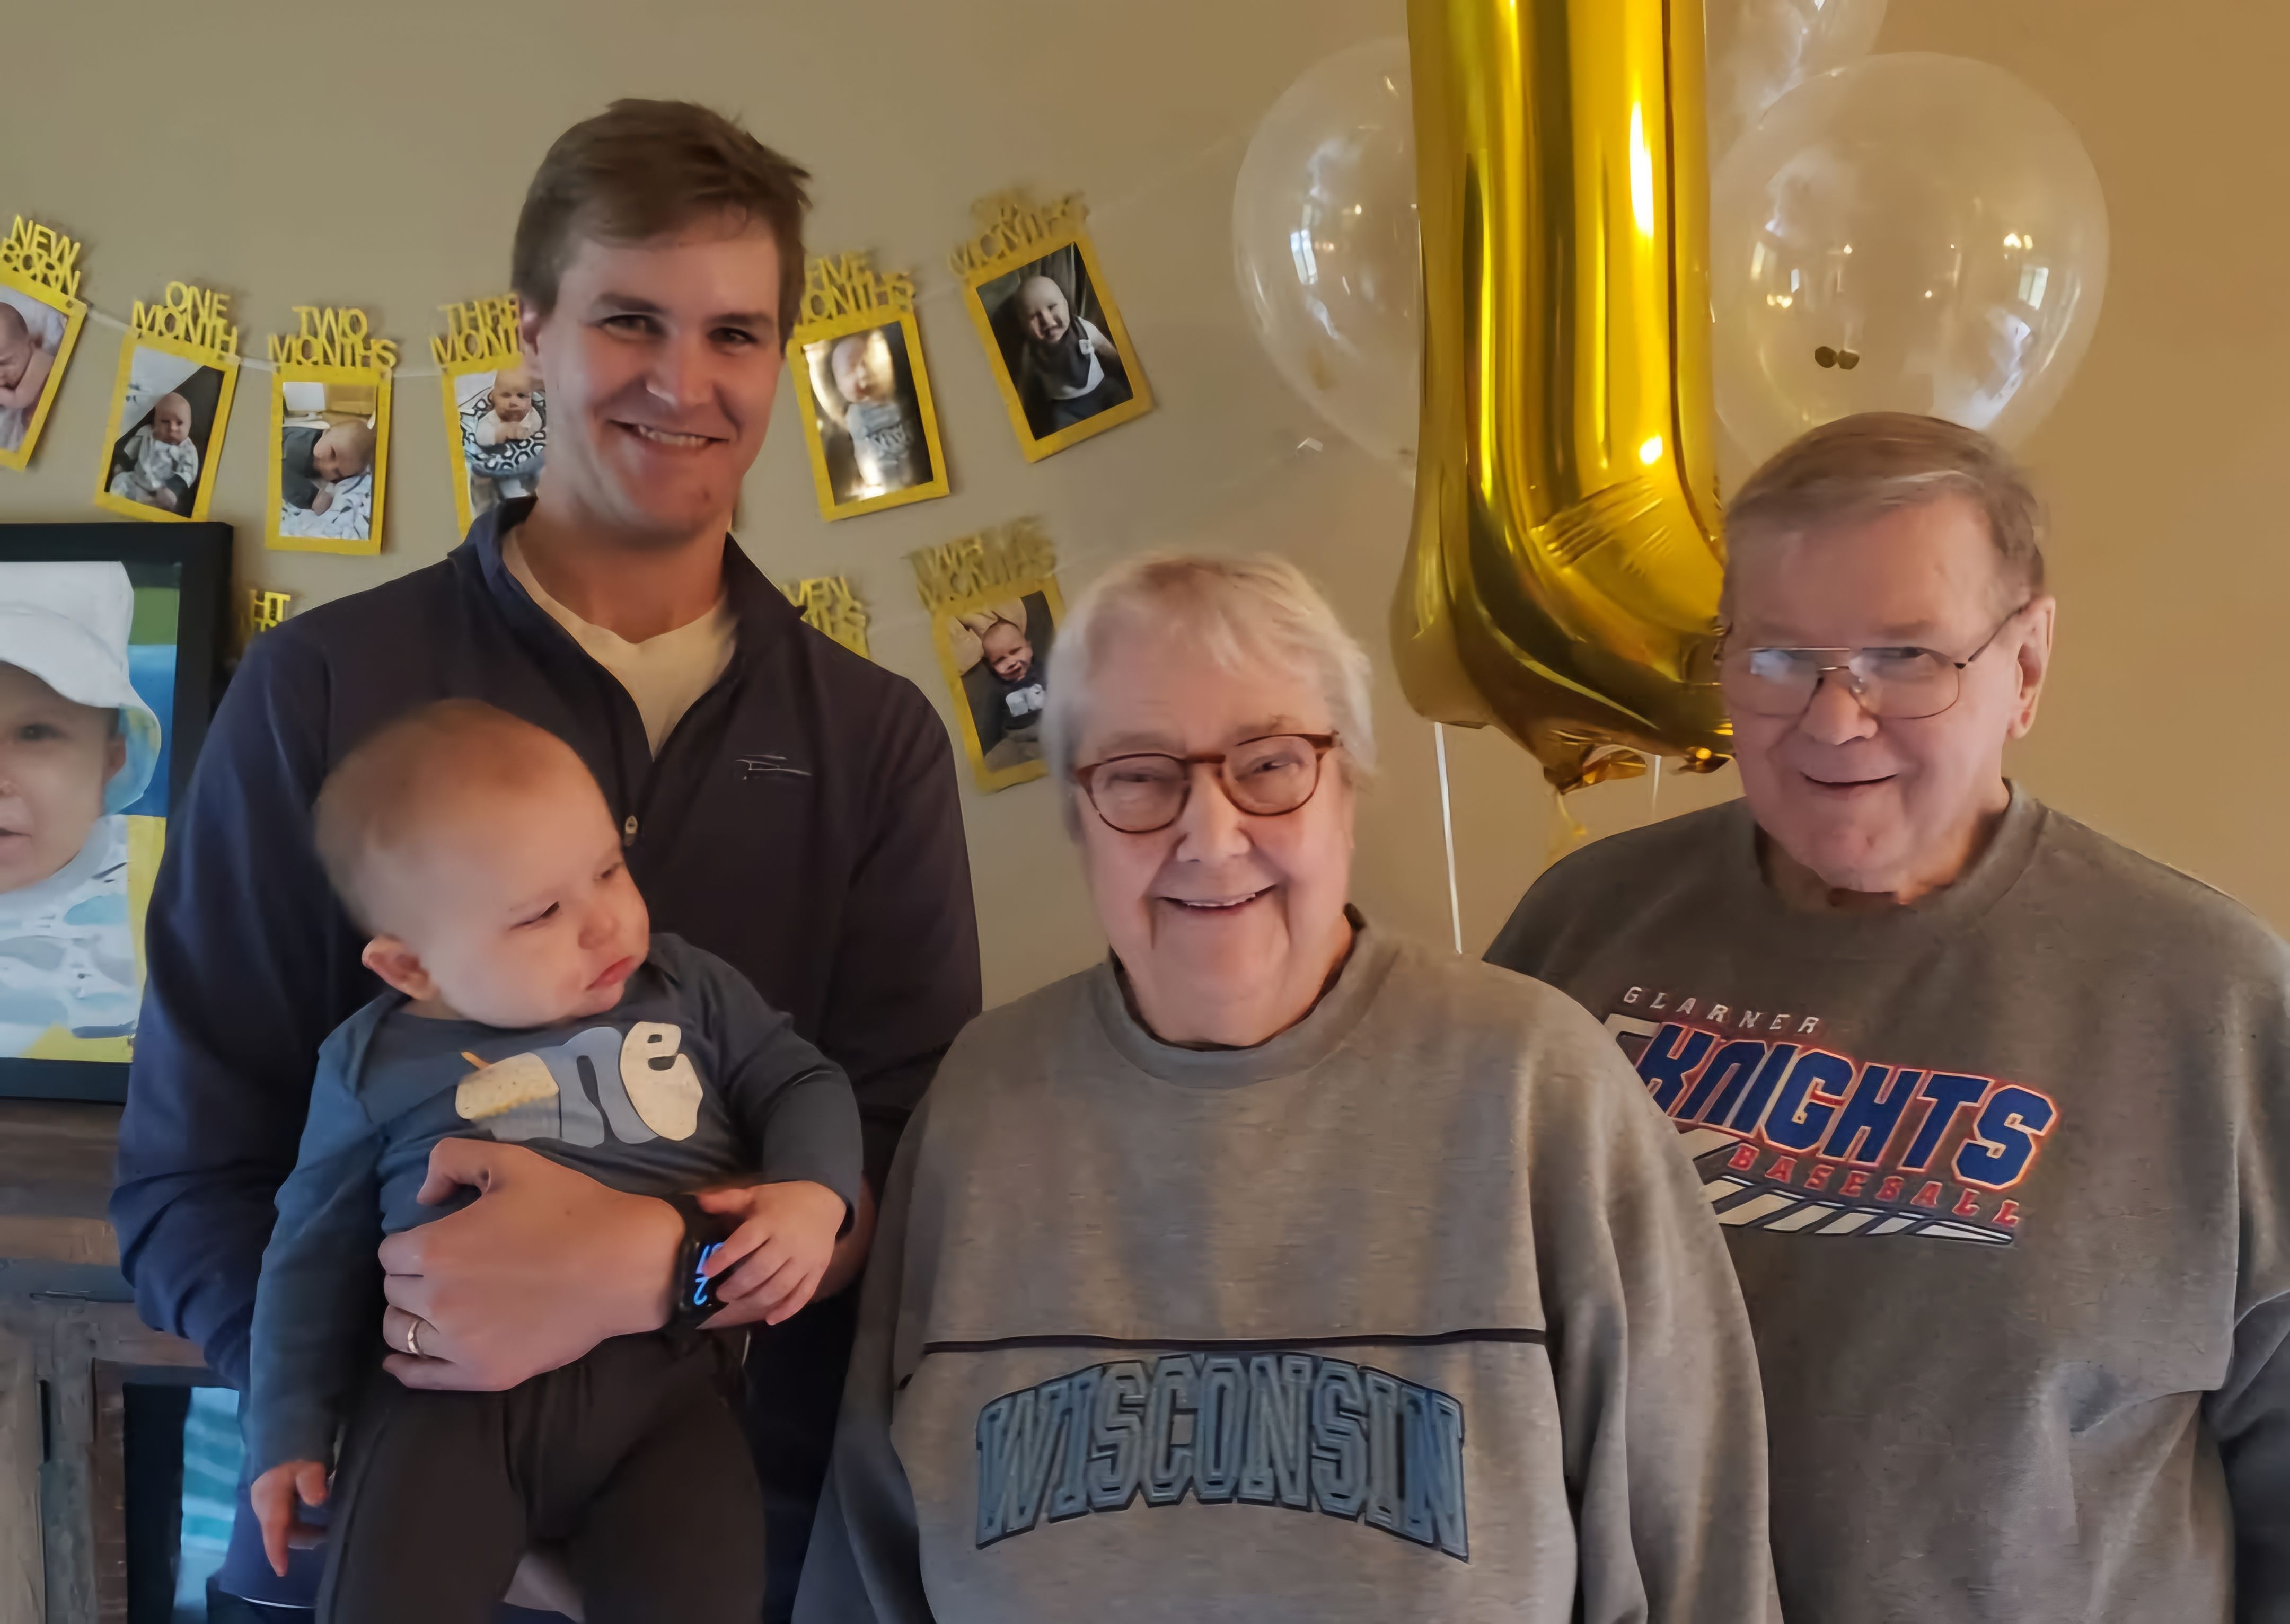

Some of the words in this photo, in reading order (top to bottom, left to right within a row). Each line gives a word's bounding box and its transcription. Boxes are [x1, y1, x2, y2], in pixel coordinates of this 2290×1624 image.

[0, 237, 81, 299] BORN
[11, 213, 81, 268] NEW
[165, 281, 230, 321] ONE
[292, 306, 368, 342] TWO
[798, 269, 915, 325] ONTHS
[133, 300, 238, 357] MONTH
[268, 333, 398, 371] MONTHS
[429, 318, 521, 366] MONT
[1623, 986, 1820, 1034] GLARNER
[1635, 1020, 2062, 1191] KNIGHTS
[1727, 1142, 2020, 1228] BASEBALL
[975, 1352, 1470, 1563] WISCONSIN
